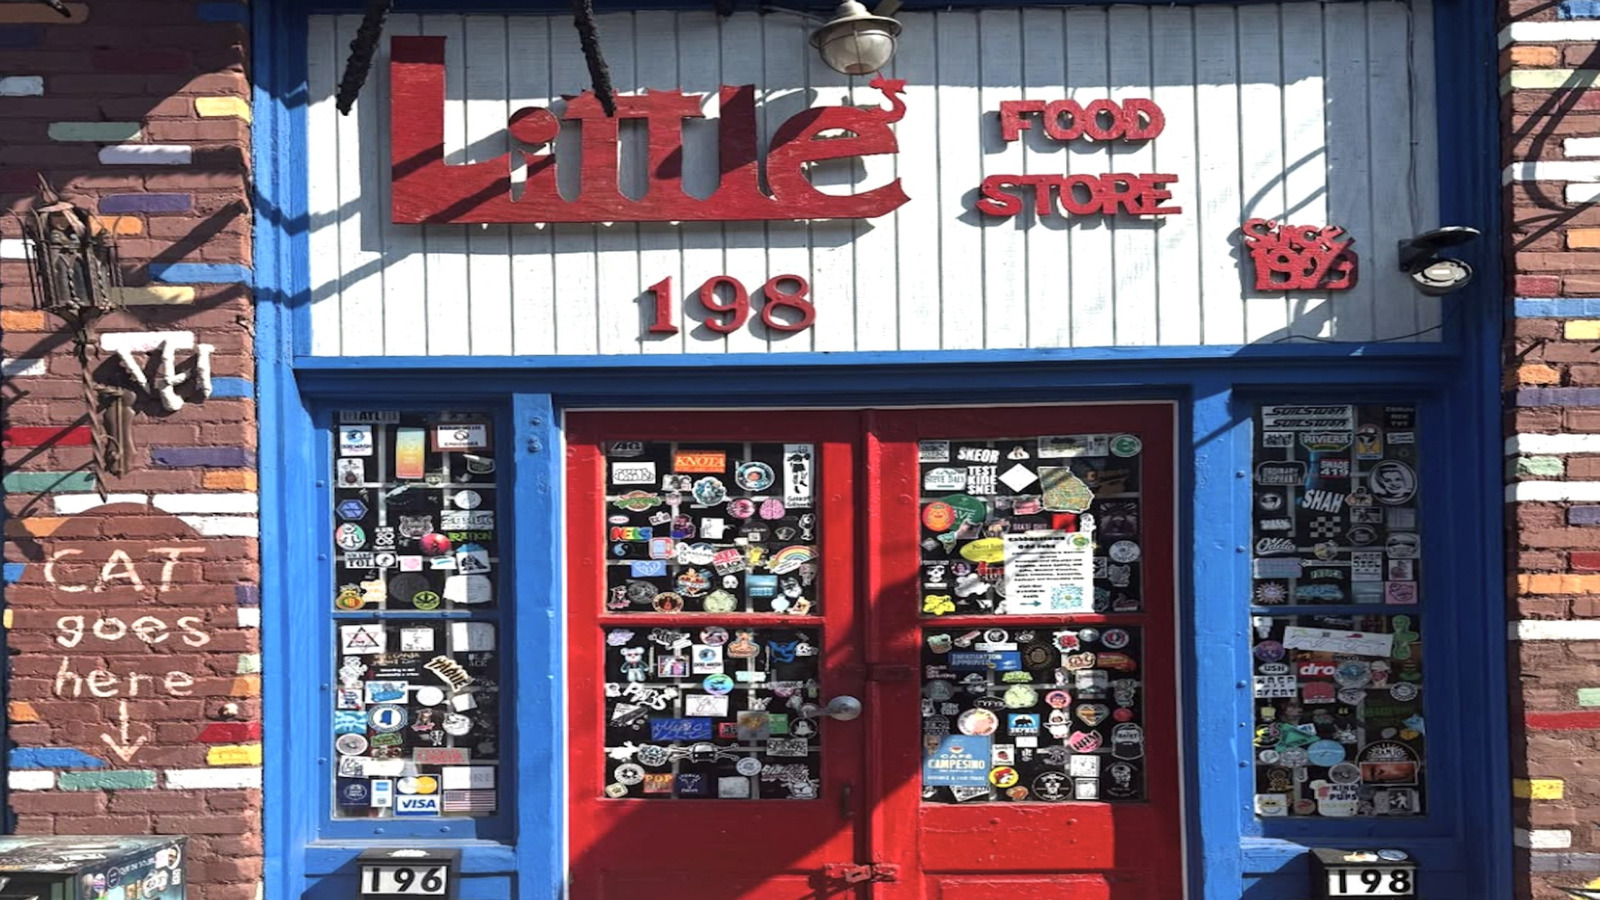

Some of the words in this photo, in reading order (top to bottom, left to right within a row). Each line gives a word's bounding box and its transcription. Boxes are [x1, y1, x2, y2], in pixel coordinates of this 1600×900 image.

[1000, 98, 1165, 142] FOOD
[975, 172, 1182, 216] STORE
[647, 274, 817, 334] 198
[967, 465, 998, 475] TEST
[44, 546, 206, 593] CAT
[56, 615, 211, 649] goes
[56, 656, 195, 698] here
[927, 759, 986, 770] CAMPESINO
[402, 799, 436, 809] VISA
[371, 867, 443, 893] 196
[1338, 869, 1412, 894] 198
